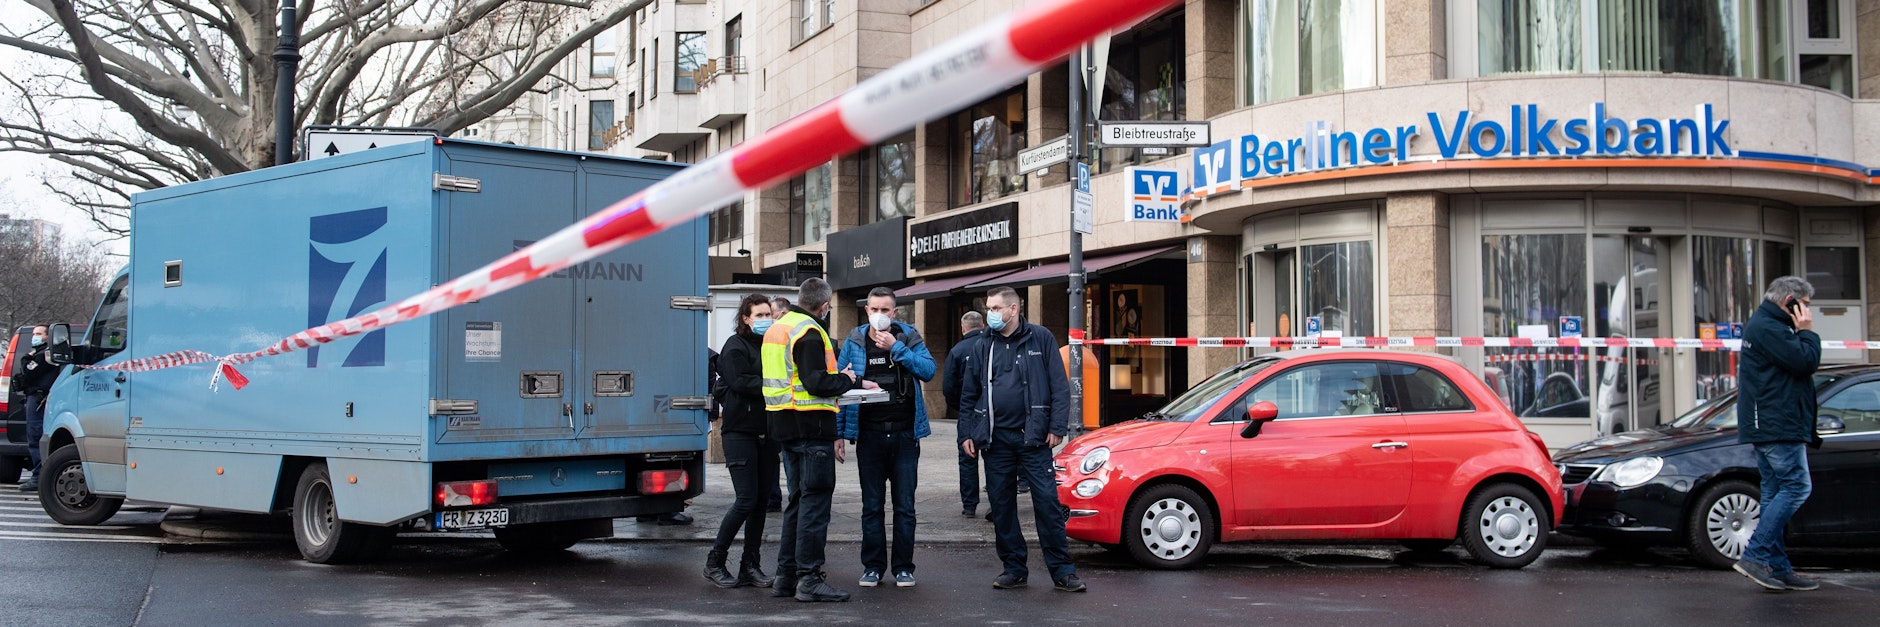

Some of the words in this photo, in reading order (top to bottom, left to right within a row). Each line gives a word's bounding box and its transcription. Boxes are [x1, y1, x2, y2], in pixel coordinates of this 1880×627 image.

[1113, 127, 1196, 142] Bleibtreustraße
[1241, 120, 1419, 179] Berliner
[1427, 102, 1733, 159] Volksbank
[1021, 144, 1066, 166] Kurfürstendamm
[1134, 204, 1178, 221] Bank
[917, 234, 940, 254] DELFI
[1190, 243, 1202, 257] 46
[798, 258, 822, 266] ba&sh
[853, 254, 871, 269] ba&sh
[547, 260, 643, 282] EMANN
[467, 511, 475, 525] Z
[478, 510, 507, 525] 3230
